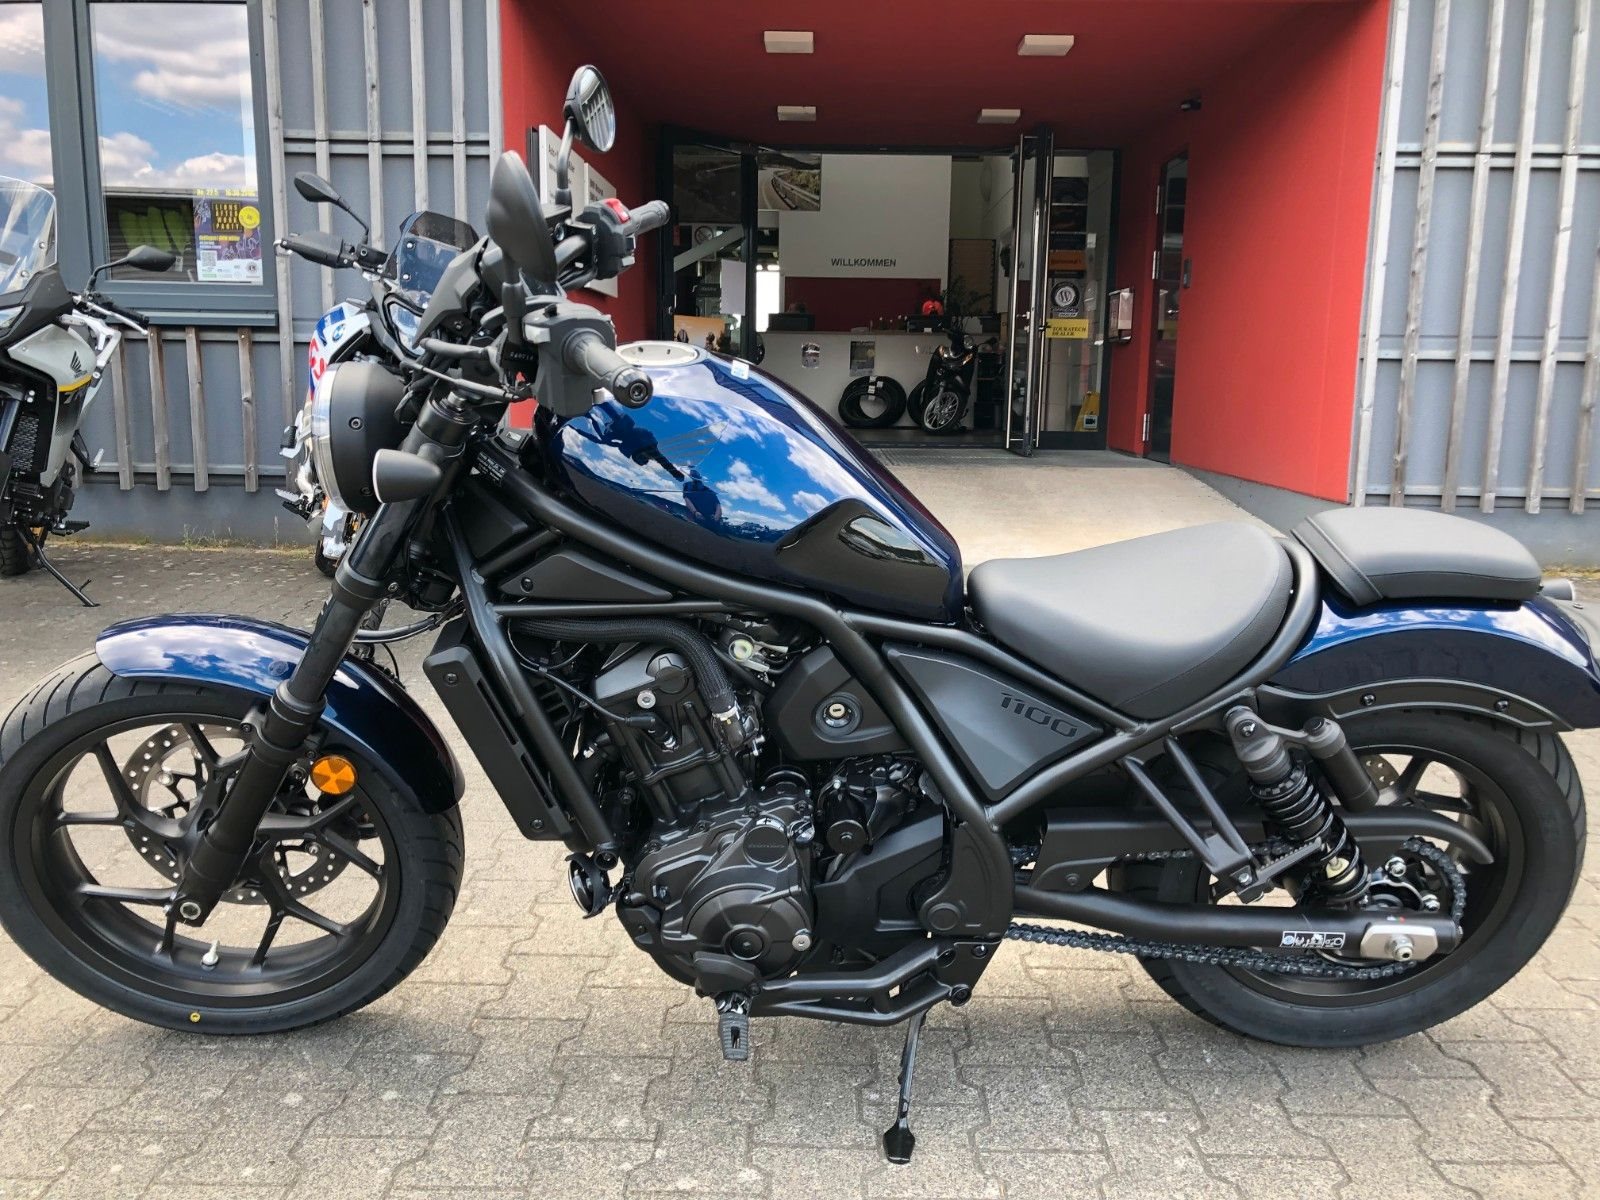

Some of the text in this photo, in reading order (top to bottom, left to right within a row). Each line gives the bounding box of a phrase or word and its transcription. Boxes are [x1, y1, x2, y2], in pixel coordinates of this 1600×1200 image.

[215, 203, 238, 211] LIONS
[831, 258, 897, 267] WILLKOMMEN
[1001, 692, 1077, 737] 1100
